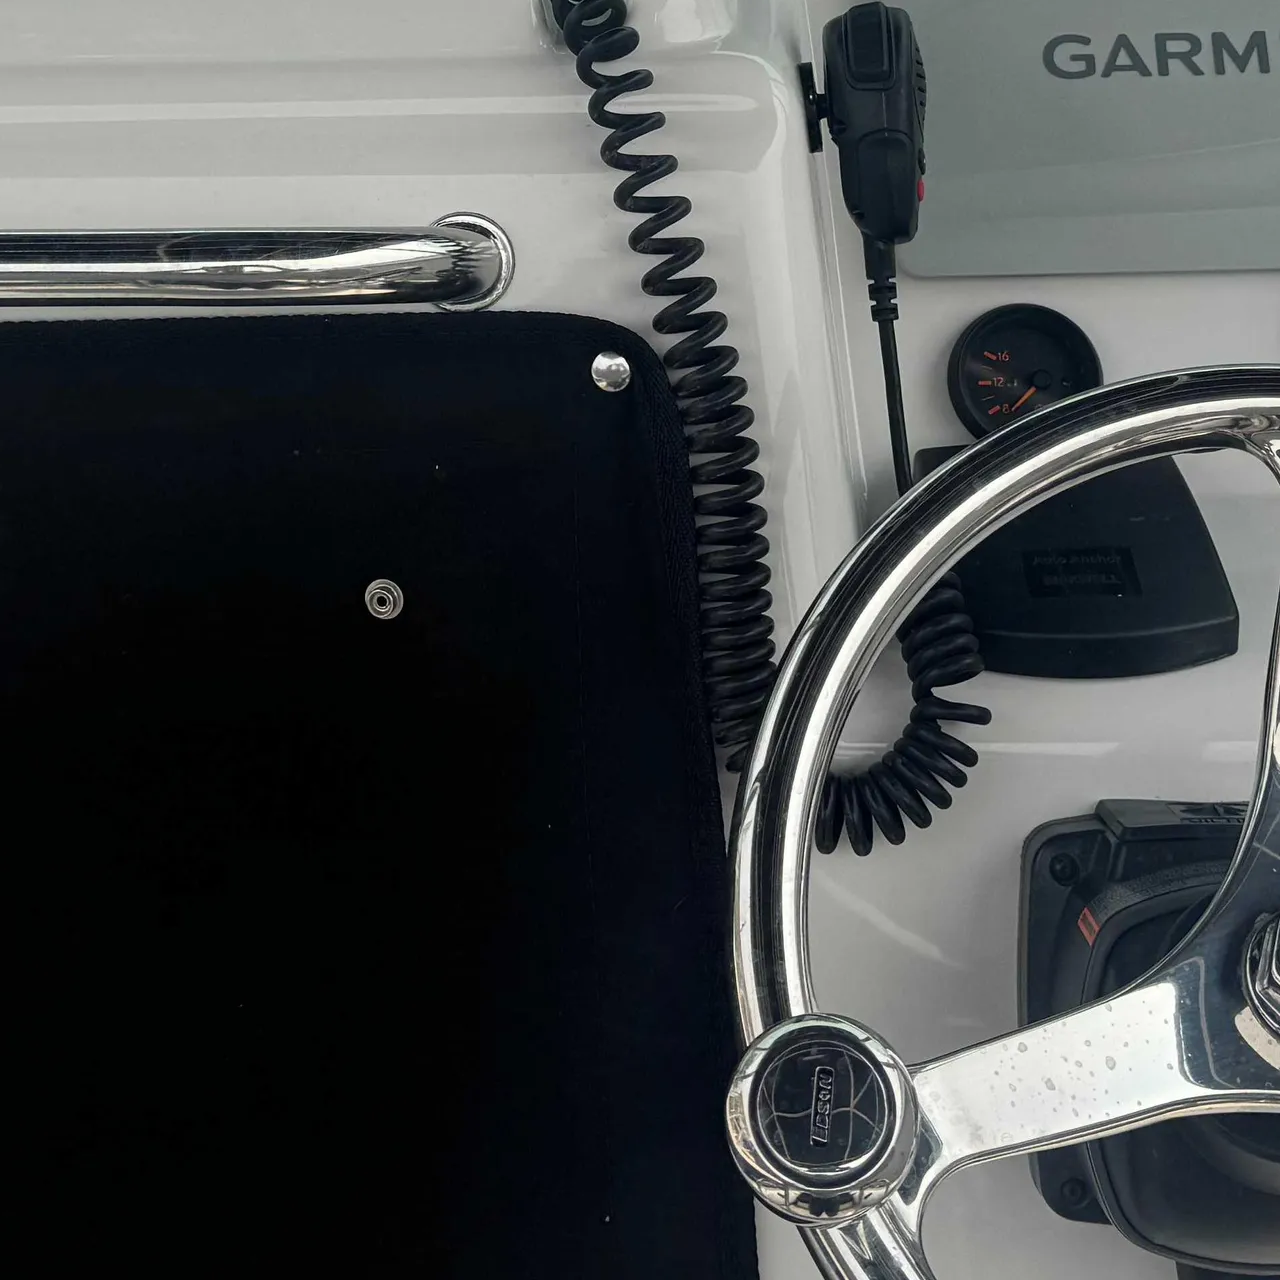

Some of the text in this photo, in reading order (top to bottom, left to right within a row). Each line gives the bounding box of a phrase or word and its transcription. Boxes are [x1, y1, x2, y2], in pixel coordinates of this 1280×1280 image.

[997, 351, 1010, 363] 16
[993, 376, 1005, 388] 12
[1001, 404, 1009, 414] 8
[811, 1073, 833, 1143] EDSON
